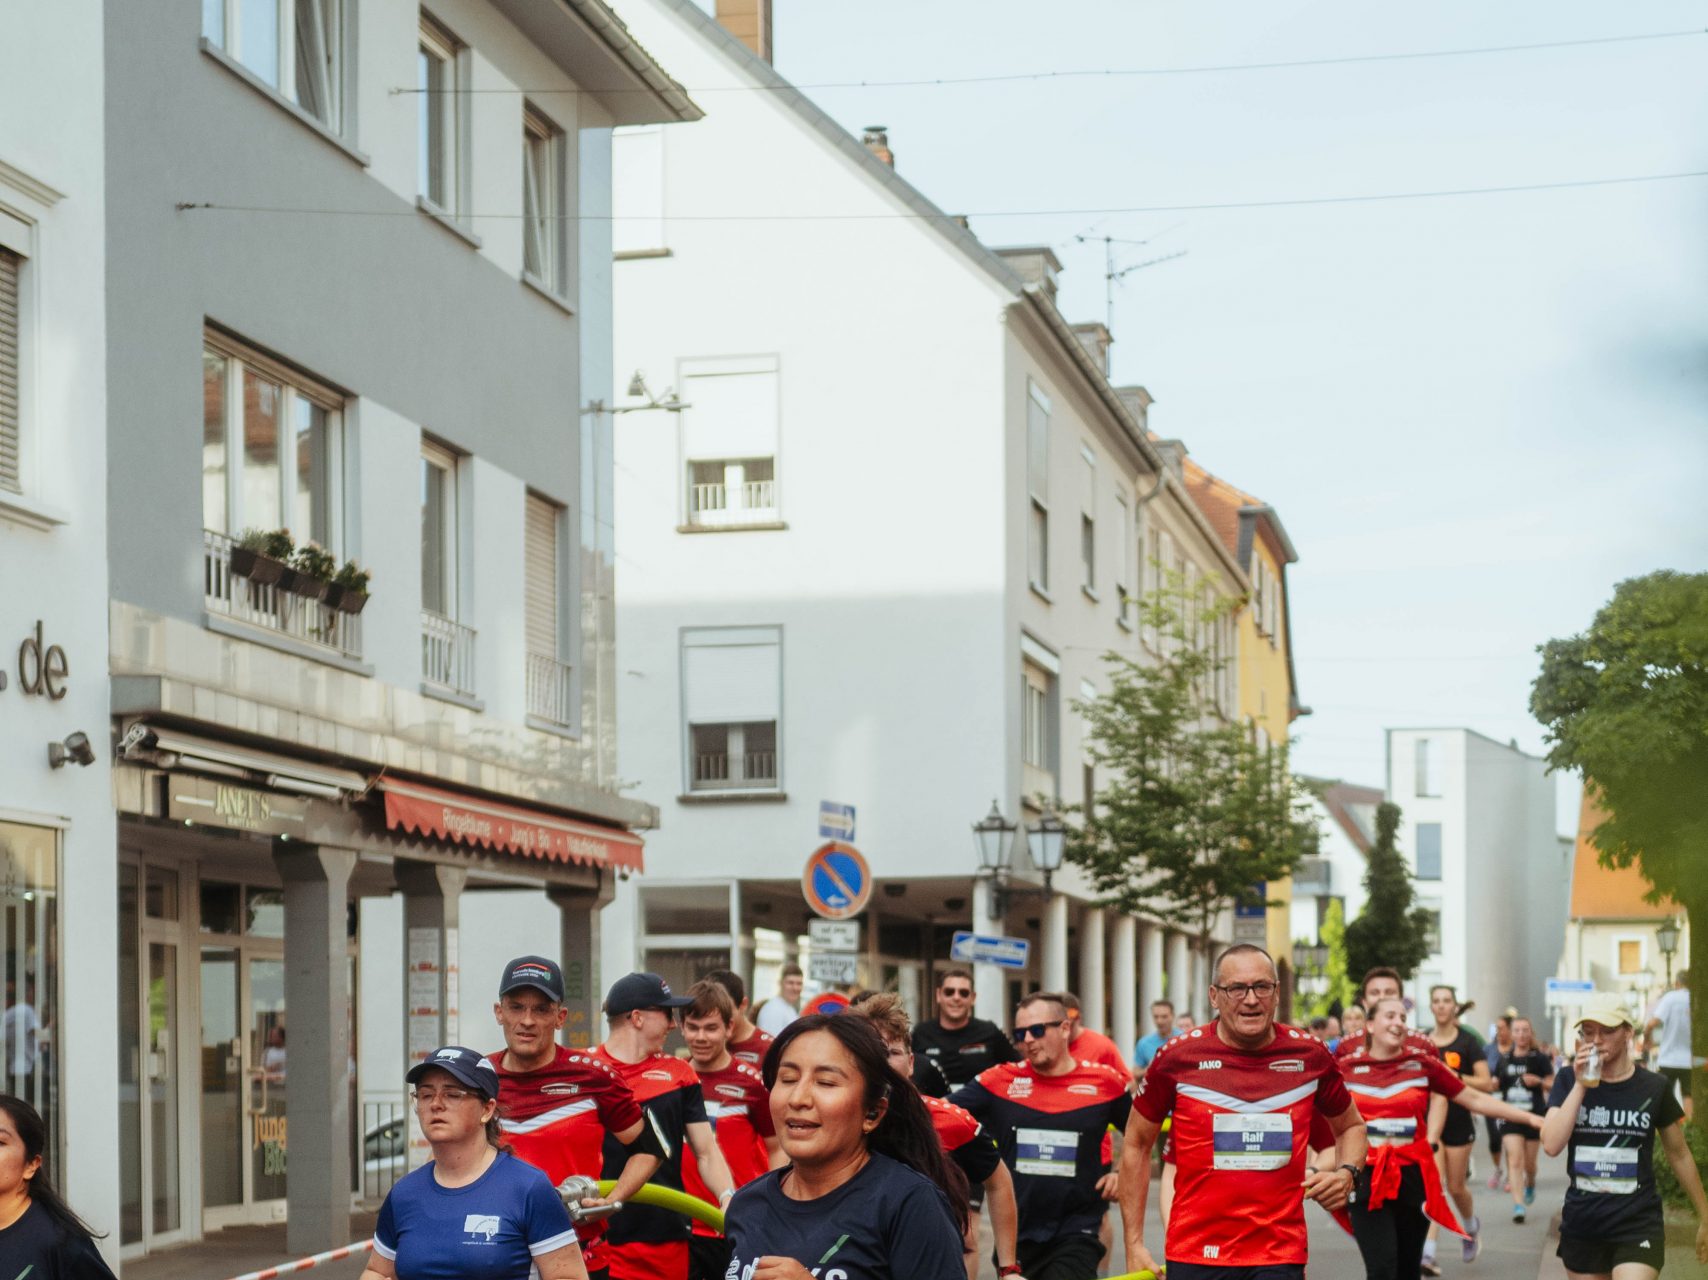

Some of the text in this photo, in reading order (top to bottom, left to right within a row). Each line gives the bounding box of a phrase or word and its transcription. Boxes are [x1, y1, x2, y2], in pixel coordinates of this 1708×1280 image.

[215, 784, 270, 820] JANET'S
[442, 807, 491, 838] Ringelblume
[509, 824, 535, 850] Jung's
[1198, 1060, 1222, 1070] JAKO
[1613, 1109, 1651, 1129] UKS
[1242, 1131, 1264, 1143] Ralf
[1038, 1144, 1055, 1154] Tim
[1594, 1162, 1617, 1172] Aline
[1203, 1245, 1220, 1258] RW
